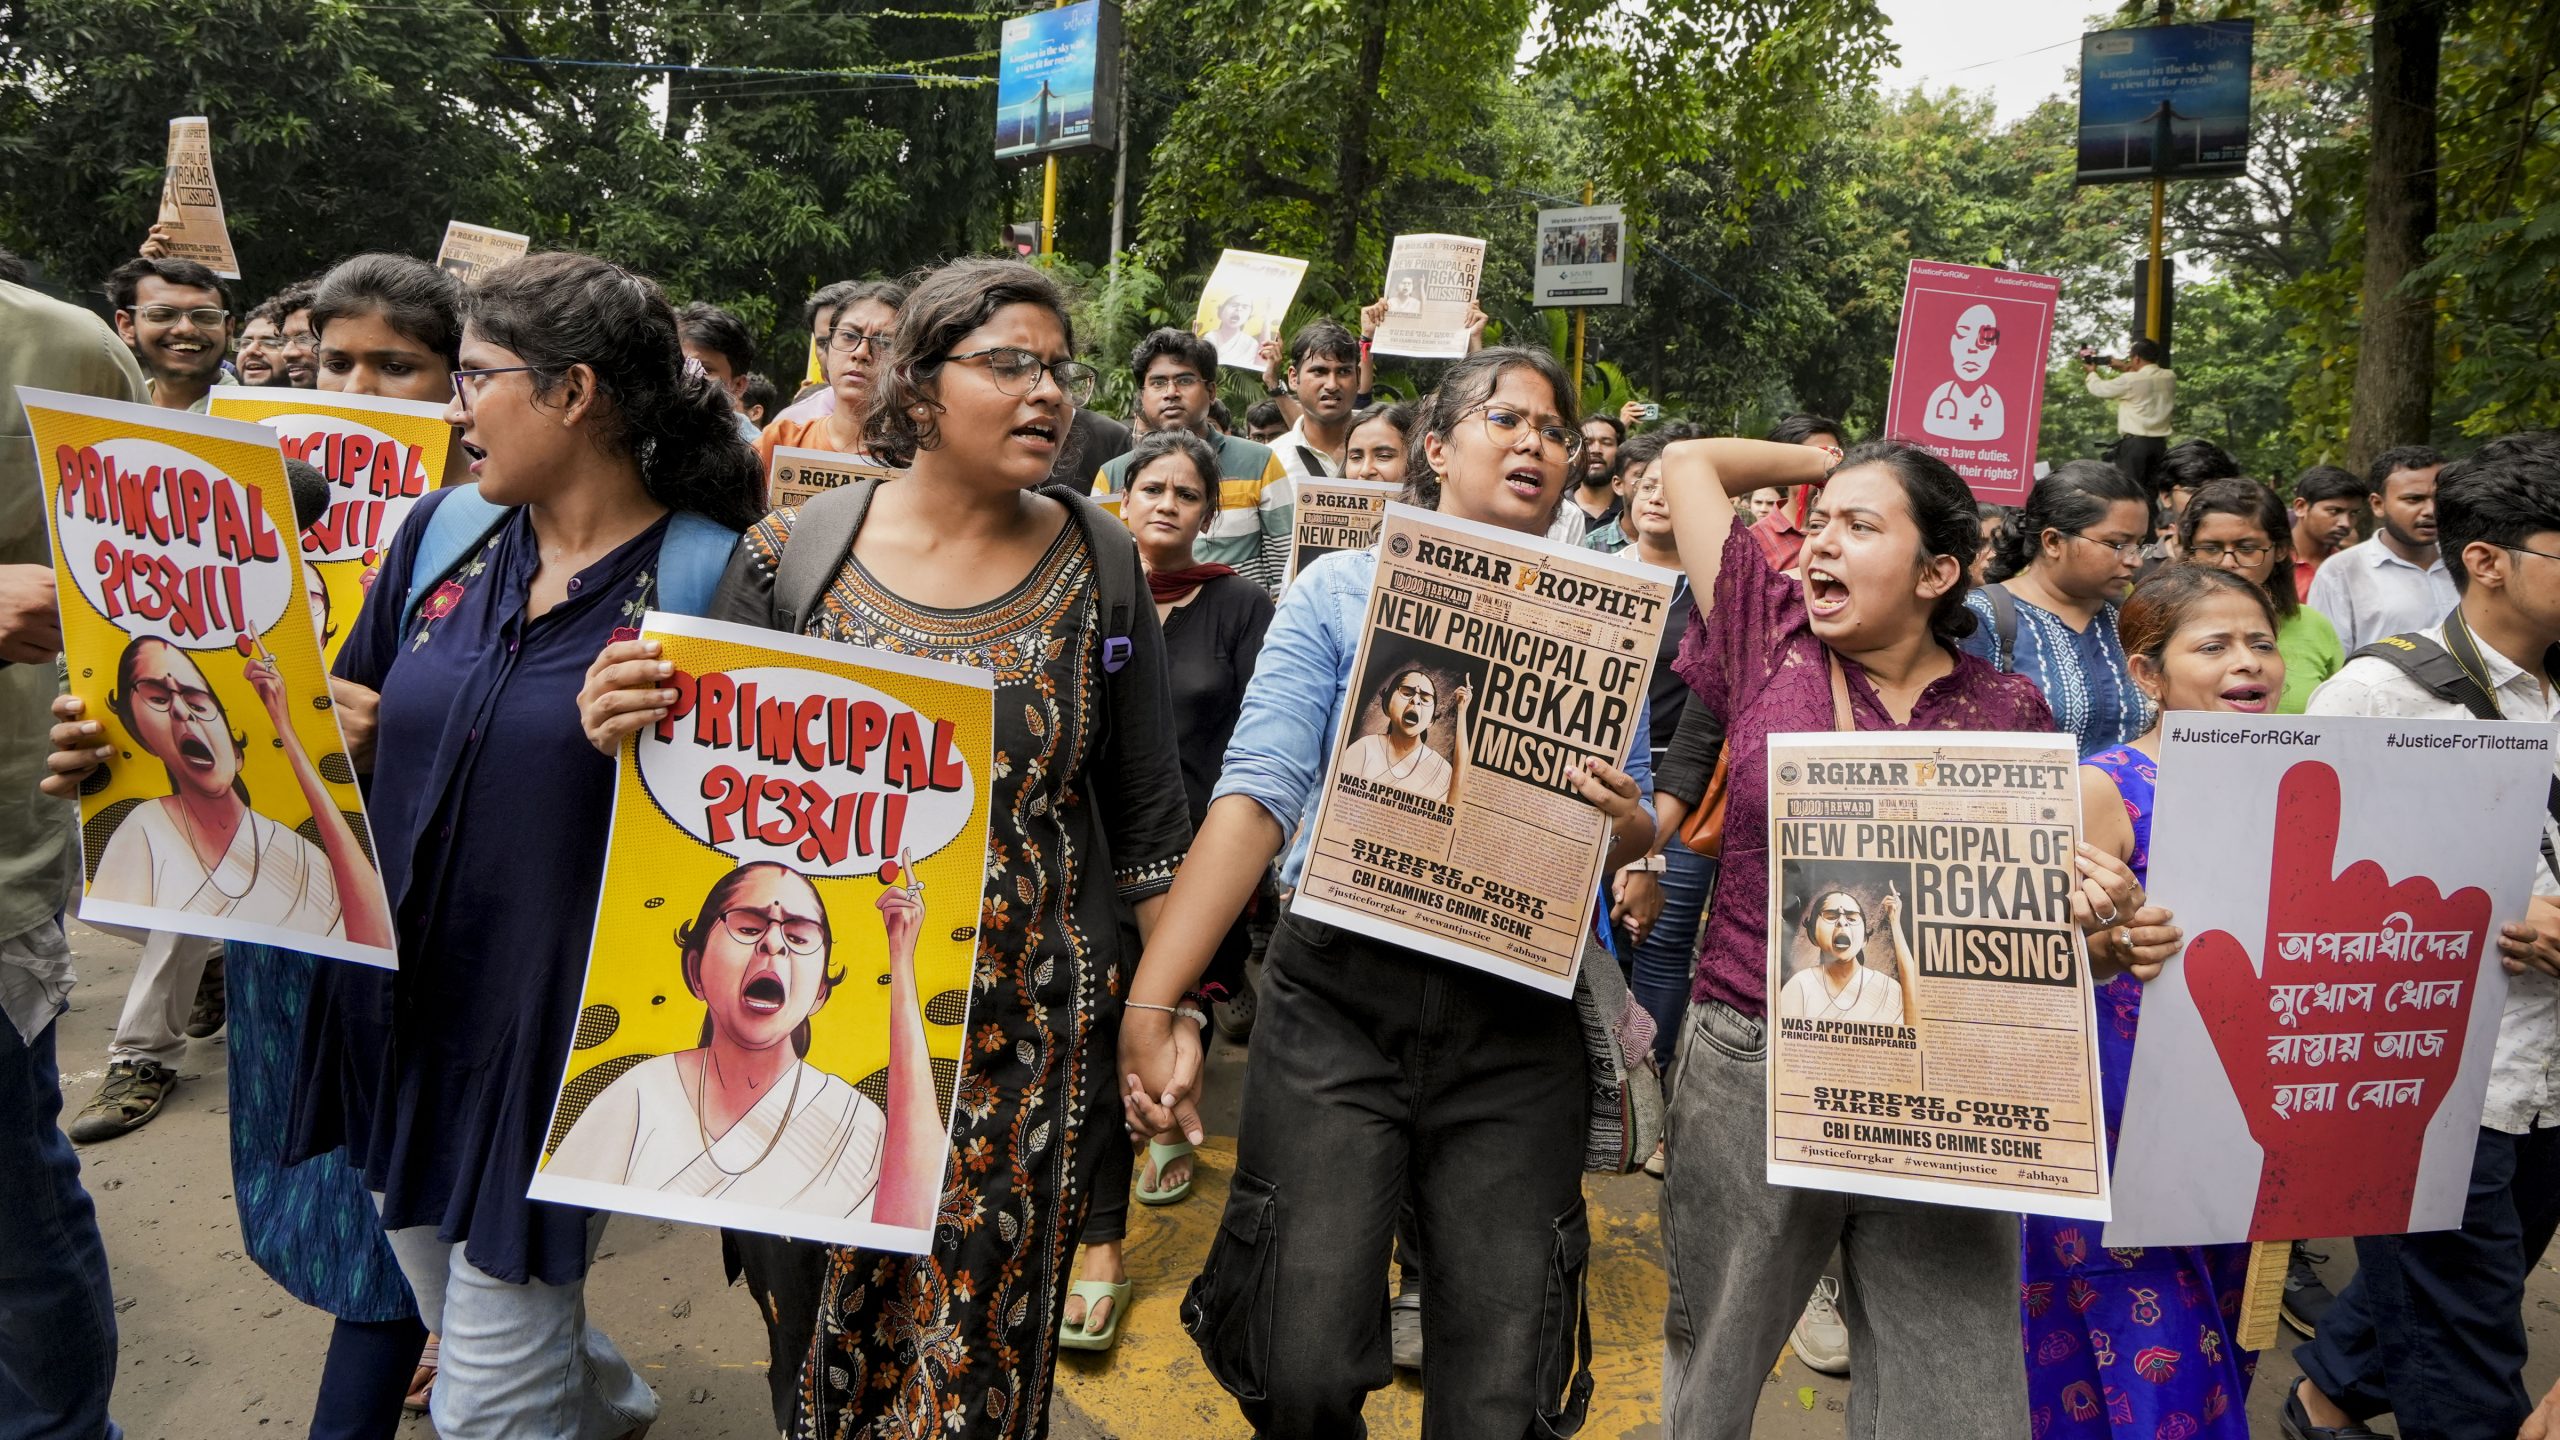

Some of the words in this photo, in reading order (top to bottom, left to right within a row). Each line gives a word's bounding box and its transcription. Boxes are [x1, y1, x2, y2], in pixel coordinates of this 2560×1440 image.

[2161, 76, 2177, 86] for
[2165, 64, 2184, 74] the
[2186, 62, 2204, 74] sky
[199, 153, 208, 165] OF
[178, 166, 212, 186] RGKAR
[180, 188, 215, 206] MISSING
[443, 247, 462, 259] NEW
[1414, 259, 1462, 271] PRINCIPAL
[1465, 263, 1477, 273] OF
[1429, 270, 1475, 288] RGKAR
[1429, 287, 1471, 302] MISSING
[1952, 446, 1975, 459] have
[1978, 449, 2010, 462] duties.
[1959, 464, 1982, 476] their
[1984, 467, 2018, 481] rights?
[56, 444, 279, 564] PRINCIPAL
[1316, 494, 1368, 510] RGKAR
[1299, 525, 1334, 546] NEW
[1393, 572, 1426, 596] 10,000
[1430, 583, 1470, 604] REWARD
[1415, 539, 1512, 586] RGKAR
[1514, 565, 1661, 624] PROPHET
[1376, 593, 1445, 642] NEW
[1444, 613, 1590, 686] PRINCIPAL
[1599, 657, 1642, 696] OF
[1483, 663, 1629, 752] RGKAR
[654, 670, 964, 793] PRINCIPAL
[2171, 727, 2321, 746] #JusticeForRGKar
[2386, 732, 2548, 751] #JusticeForTilottama
[1477, 723, 1600, 795] MISSIN
[1806, 762, 1909, 785] RGKAR
[1914, 760, 2069, 790] PROPHET
[1337, 784, 1378, 805] PRINCIPAL
[1380, 796, 1397, 808] BUT
[1397, 801, 1453, 827] DISAPPEARED
[1339, 772, 1375, 794] WAS
[1377, 782, 1436, 811] APPOINTED
[1437, 804, 1455, 819] AS
[1789, 799, 1823, 817] 10,000
[1831, 801, 1872, 813] REWARD
[1781, 822, 1847, 857] NEW
[1856, 824, 2020, 864] PRINCIPAL
[2029, 829, 2070, 867] OF
[1351, 849, 1424, 879] TAKES
[1432, 873, 1474, 896] SUO
[1482, 889, 1545, 920] MOTO
[1353, 838, 1464, 880] SUPREME
[1471, 875, 1548, 910] COURT
[1351, 869, 1378, 891] CBI
[1378, 875, 1444, 911] EXAMINES
[1445, 897, 1490, 925] CRIME
[1490, 913, 1534, 941] SCENE
[1916, 862, 2072, 925] RGKAR
[1327, 884, 1408, 917] #justiceforrgkar
[1415, 910, 1491, 943] #wewantjustice
[1506, 940, 1547, 963] #abhaya
[2277, 910, 2473, 964] অপরাধীদের
[1924, 927, 2072, 982] MISSING
[2384, 979, 2463, 1011] খোল
[1781, 1018, 1813, 1032] WAS
[1816, 1020, 1894, 1038] APPOINTED
[1897, 1027, 1916, 1040] AS
[1781, 1030, 1829, 1043] PRINCIPAL
[1832, 1034, 1850, 1044] BUT
[1852, 1036, 1917, 1050] DISAPPEARED
[2372, 1029, 2448, 1060] আজ
[1814, 1086, 1945, 1110] SUPREME
[1956, 1100, 2050, 1119] COURT
[2347, 1078, 2425, 1112] বোল
[1814, 1099, 1901, 1118] TAKES
[1911, 1110, 1962, 1124] SUO
[1973, 1113, 2050, 1132] MOTO
[1823, 1121, 1850, 1140] CBI
[1854, 1124, 1931, 1148] EXAMINES
[1936, 1131, 1989, 1154] CRIME
[1991, 1139, 2043, 1160] SCENE
[1801, 1144, 1895, 1165] #justiceforrgkar
[1904, 1154, 1998, 1176] #wewantjustice
[2018, 1168, 2069, 1184] #abhaya
